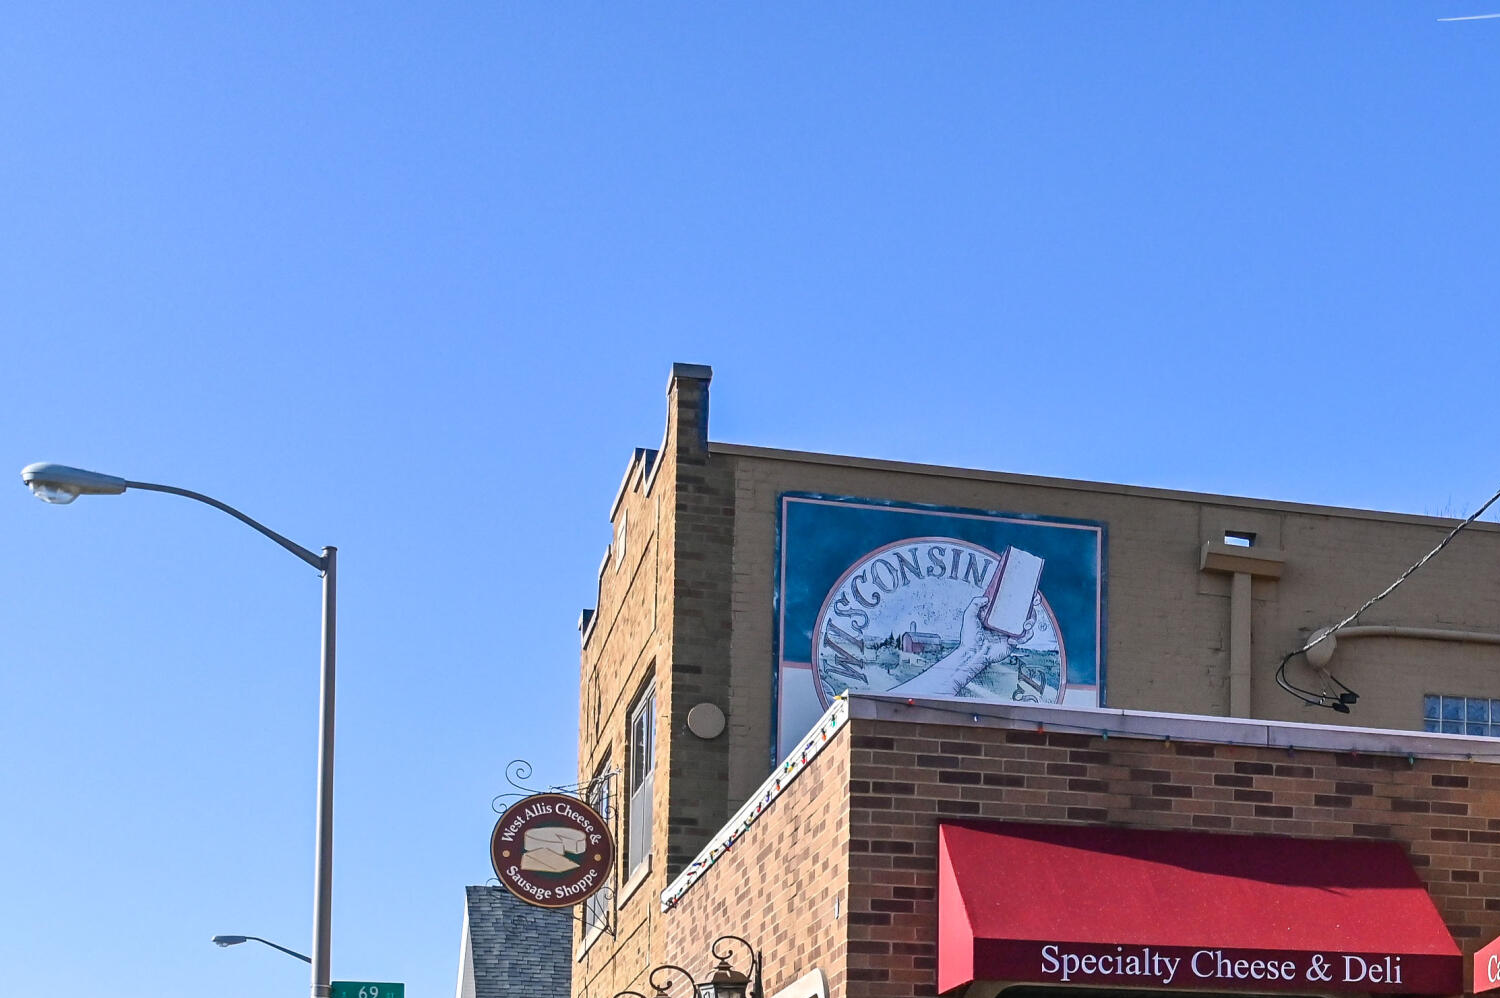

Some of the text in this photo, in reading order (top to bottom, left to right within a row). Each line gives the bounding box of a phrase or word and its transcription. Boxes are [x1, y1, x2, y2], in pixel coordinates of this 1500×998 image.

[821, 545, 993, 685] WISCONSIN
[501, 802, 602, 846] West Allis Cheese &
[506, 865, 598, 900] Sausage Shoppe
[1041, 945, 1402, 984] Specialty Cheese & Deli
